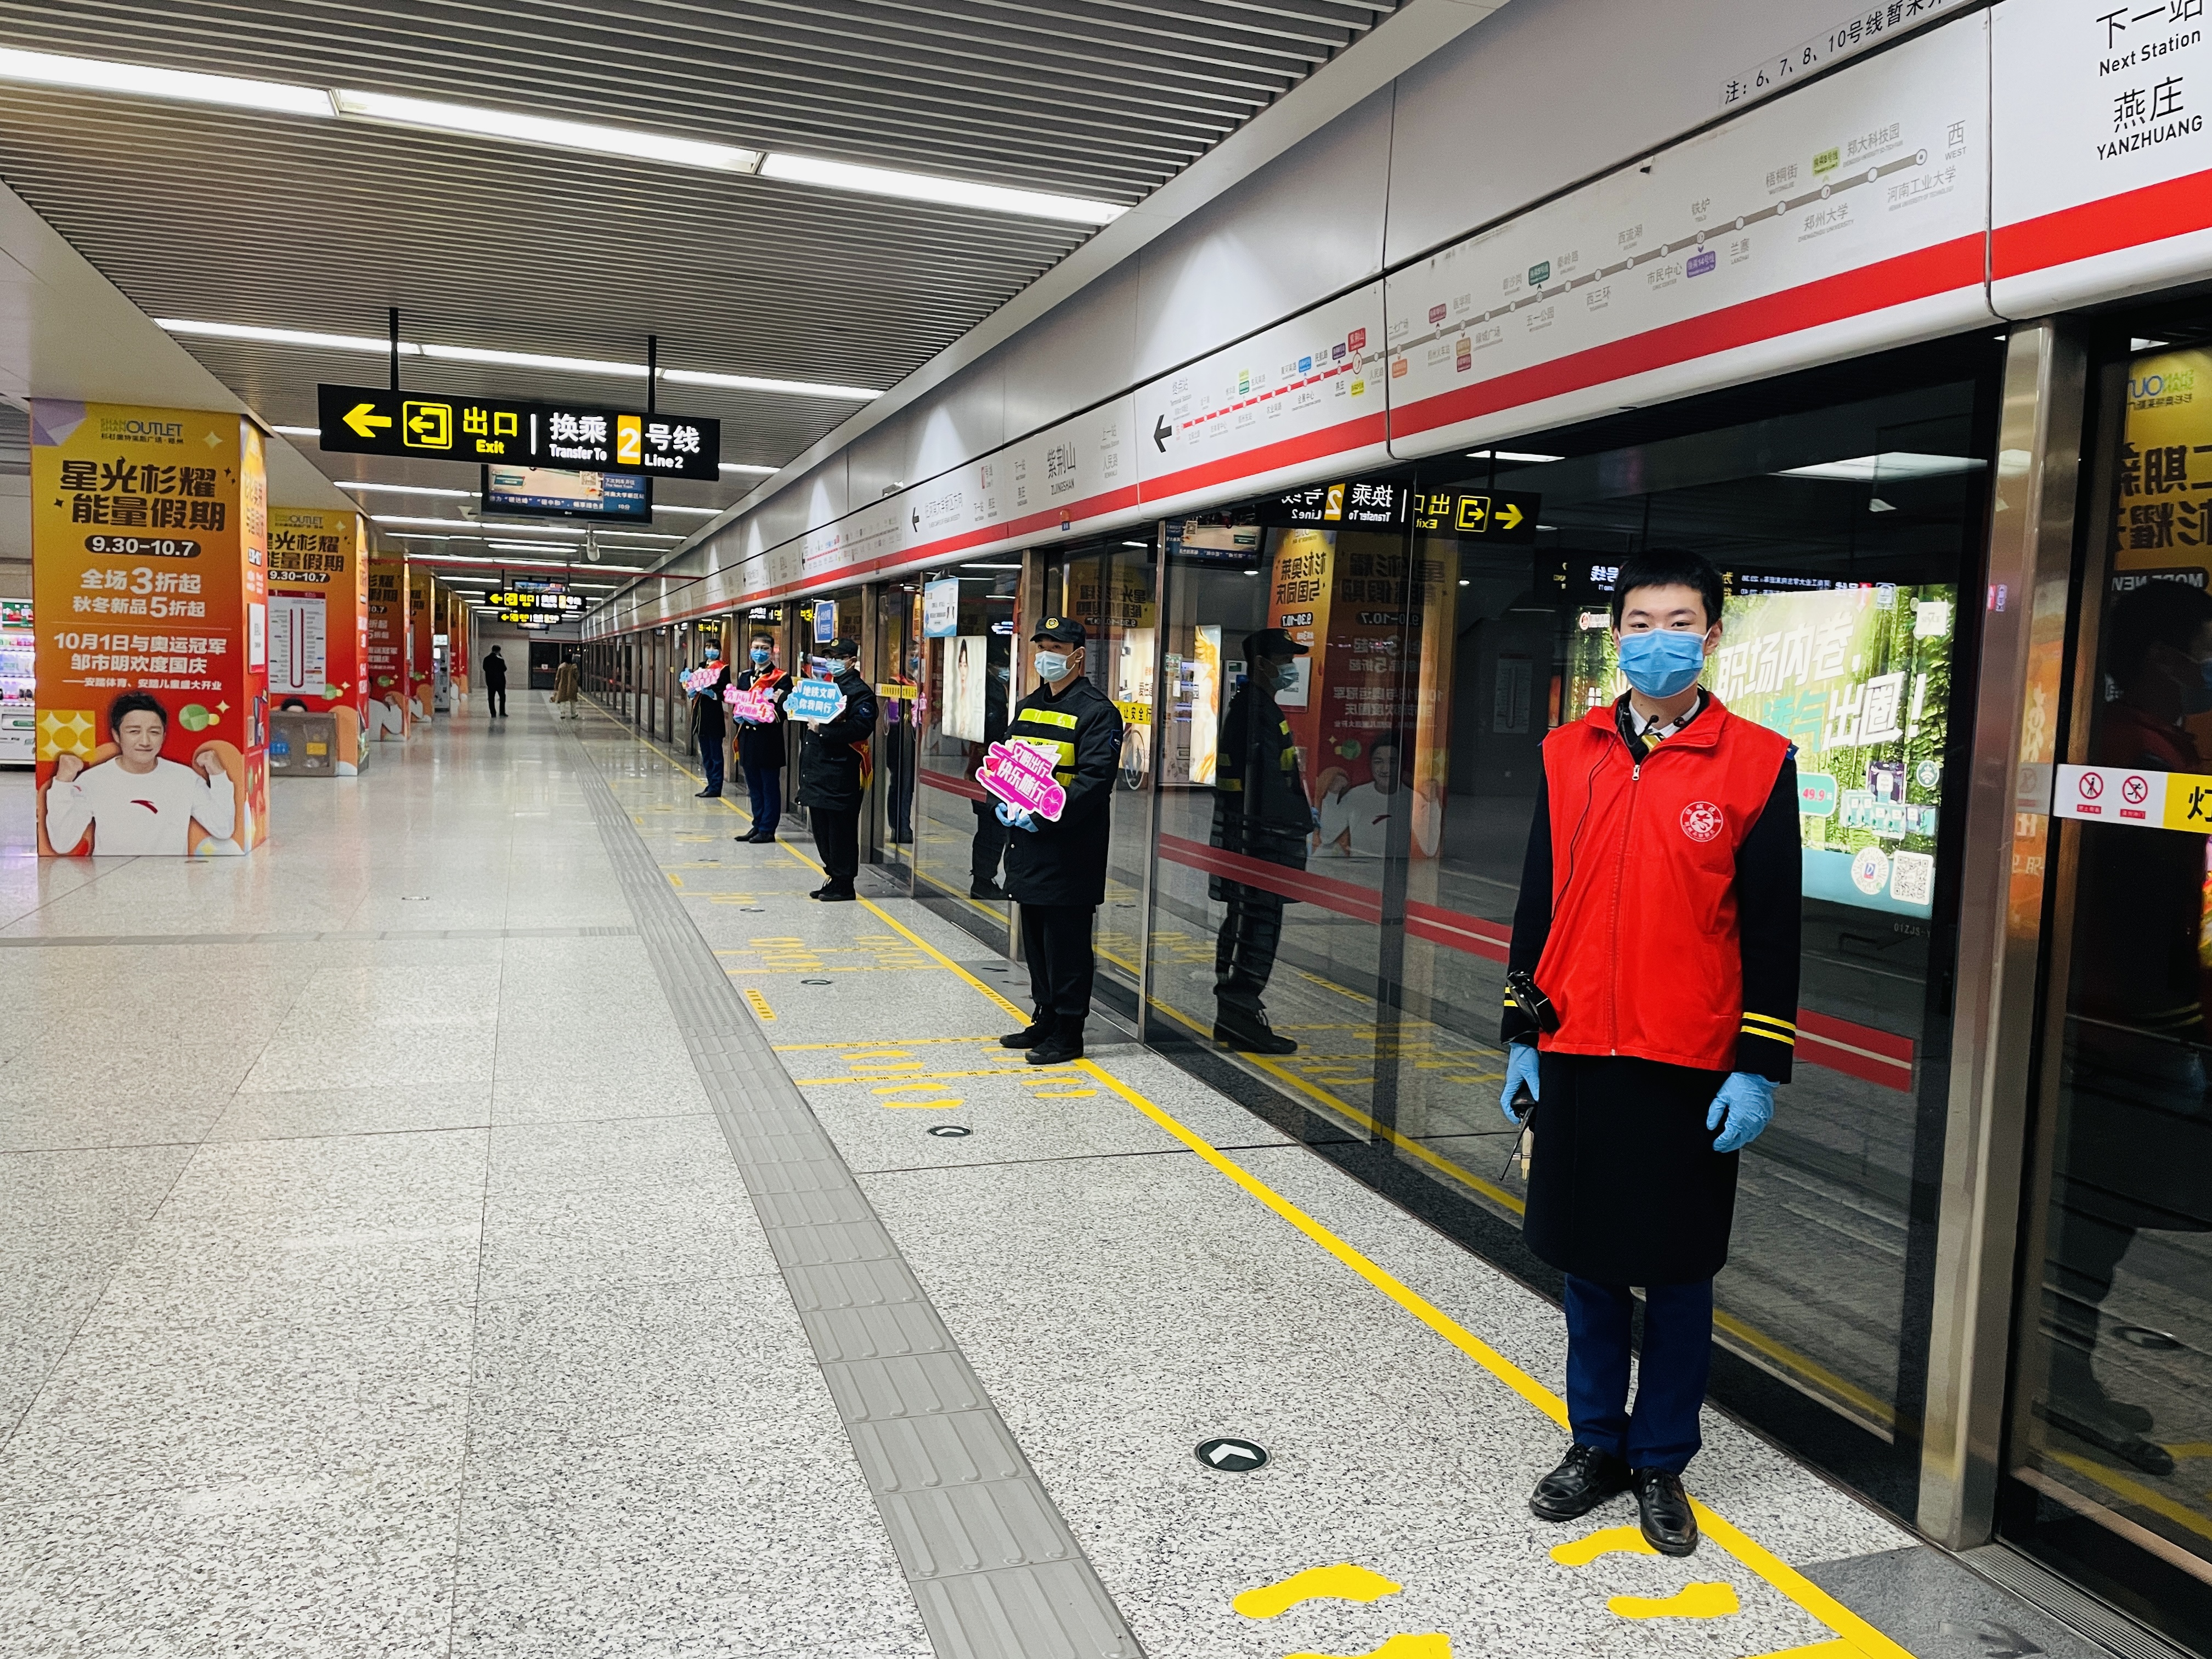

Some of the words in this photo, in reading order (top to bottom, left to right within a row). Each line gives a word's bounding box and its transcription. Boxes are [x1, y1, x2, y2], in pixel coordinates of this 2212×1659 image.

[1725, 0, 1941, 104] 注：6、7、8、10号线暂未
[2100, 50, 2136, 76] Next
[2141, 30, 2200, 61] Station
[2113, 76, 2184, 133] 燕庄
[1947, 120, 1966, 149] 西
[2097, 115, 2202, 161] YANZHUANG
[1945, 147, 1967, 161] WEST
[1887, 165, 1956, 204] 河南工业大学
[1804, 203, 1848, 231] 郑州大学
[1647, 262, 1683, 285] 市民中心
[126, 421, 183, 437] OUTLET
[463, 407, 517, 437] 出口
[476, 439, 505, 454] Exit
[549, 444, 593, 461] Transfer
[594, 447, 607, 461] To
[1047, 441, 1076, 478] 紫荆山
[60, 456, 217, 498] 星光杉耀
[72, 494, 225, 532] 能量假期
[81, 567, 201, 594] 全场3折起
[72, 596, 205, 618] 秋冬新品5折起
[54, 632, 227, 654] 10月1日与奥运冠军
[71, 653, 207, 674] 邹市明欢度国庆
[799, 698, 833, 714] 你我同行
[803, 685, 836, 700] 地铁文明
[1011, 746, 1052, 779] 文明出行
[996, 758, 1048, 803] 快乐随行
[1803, 788, 1825, 802] 49.9
